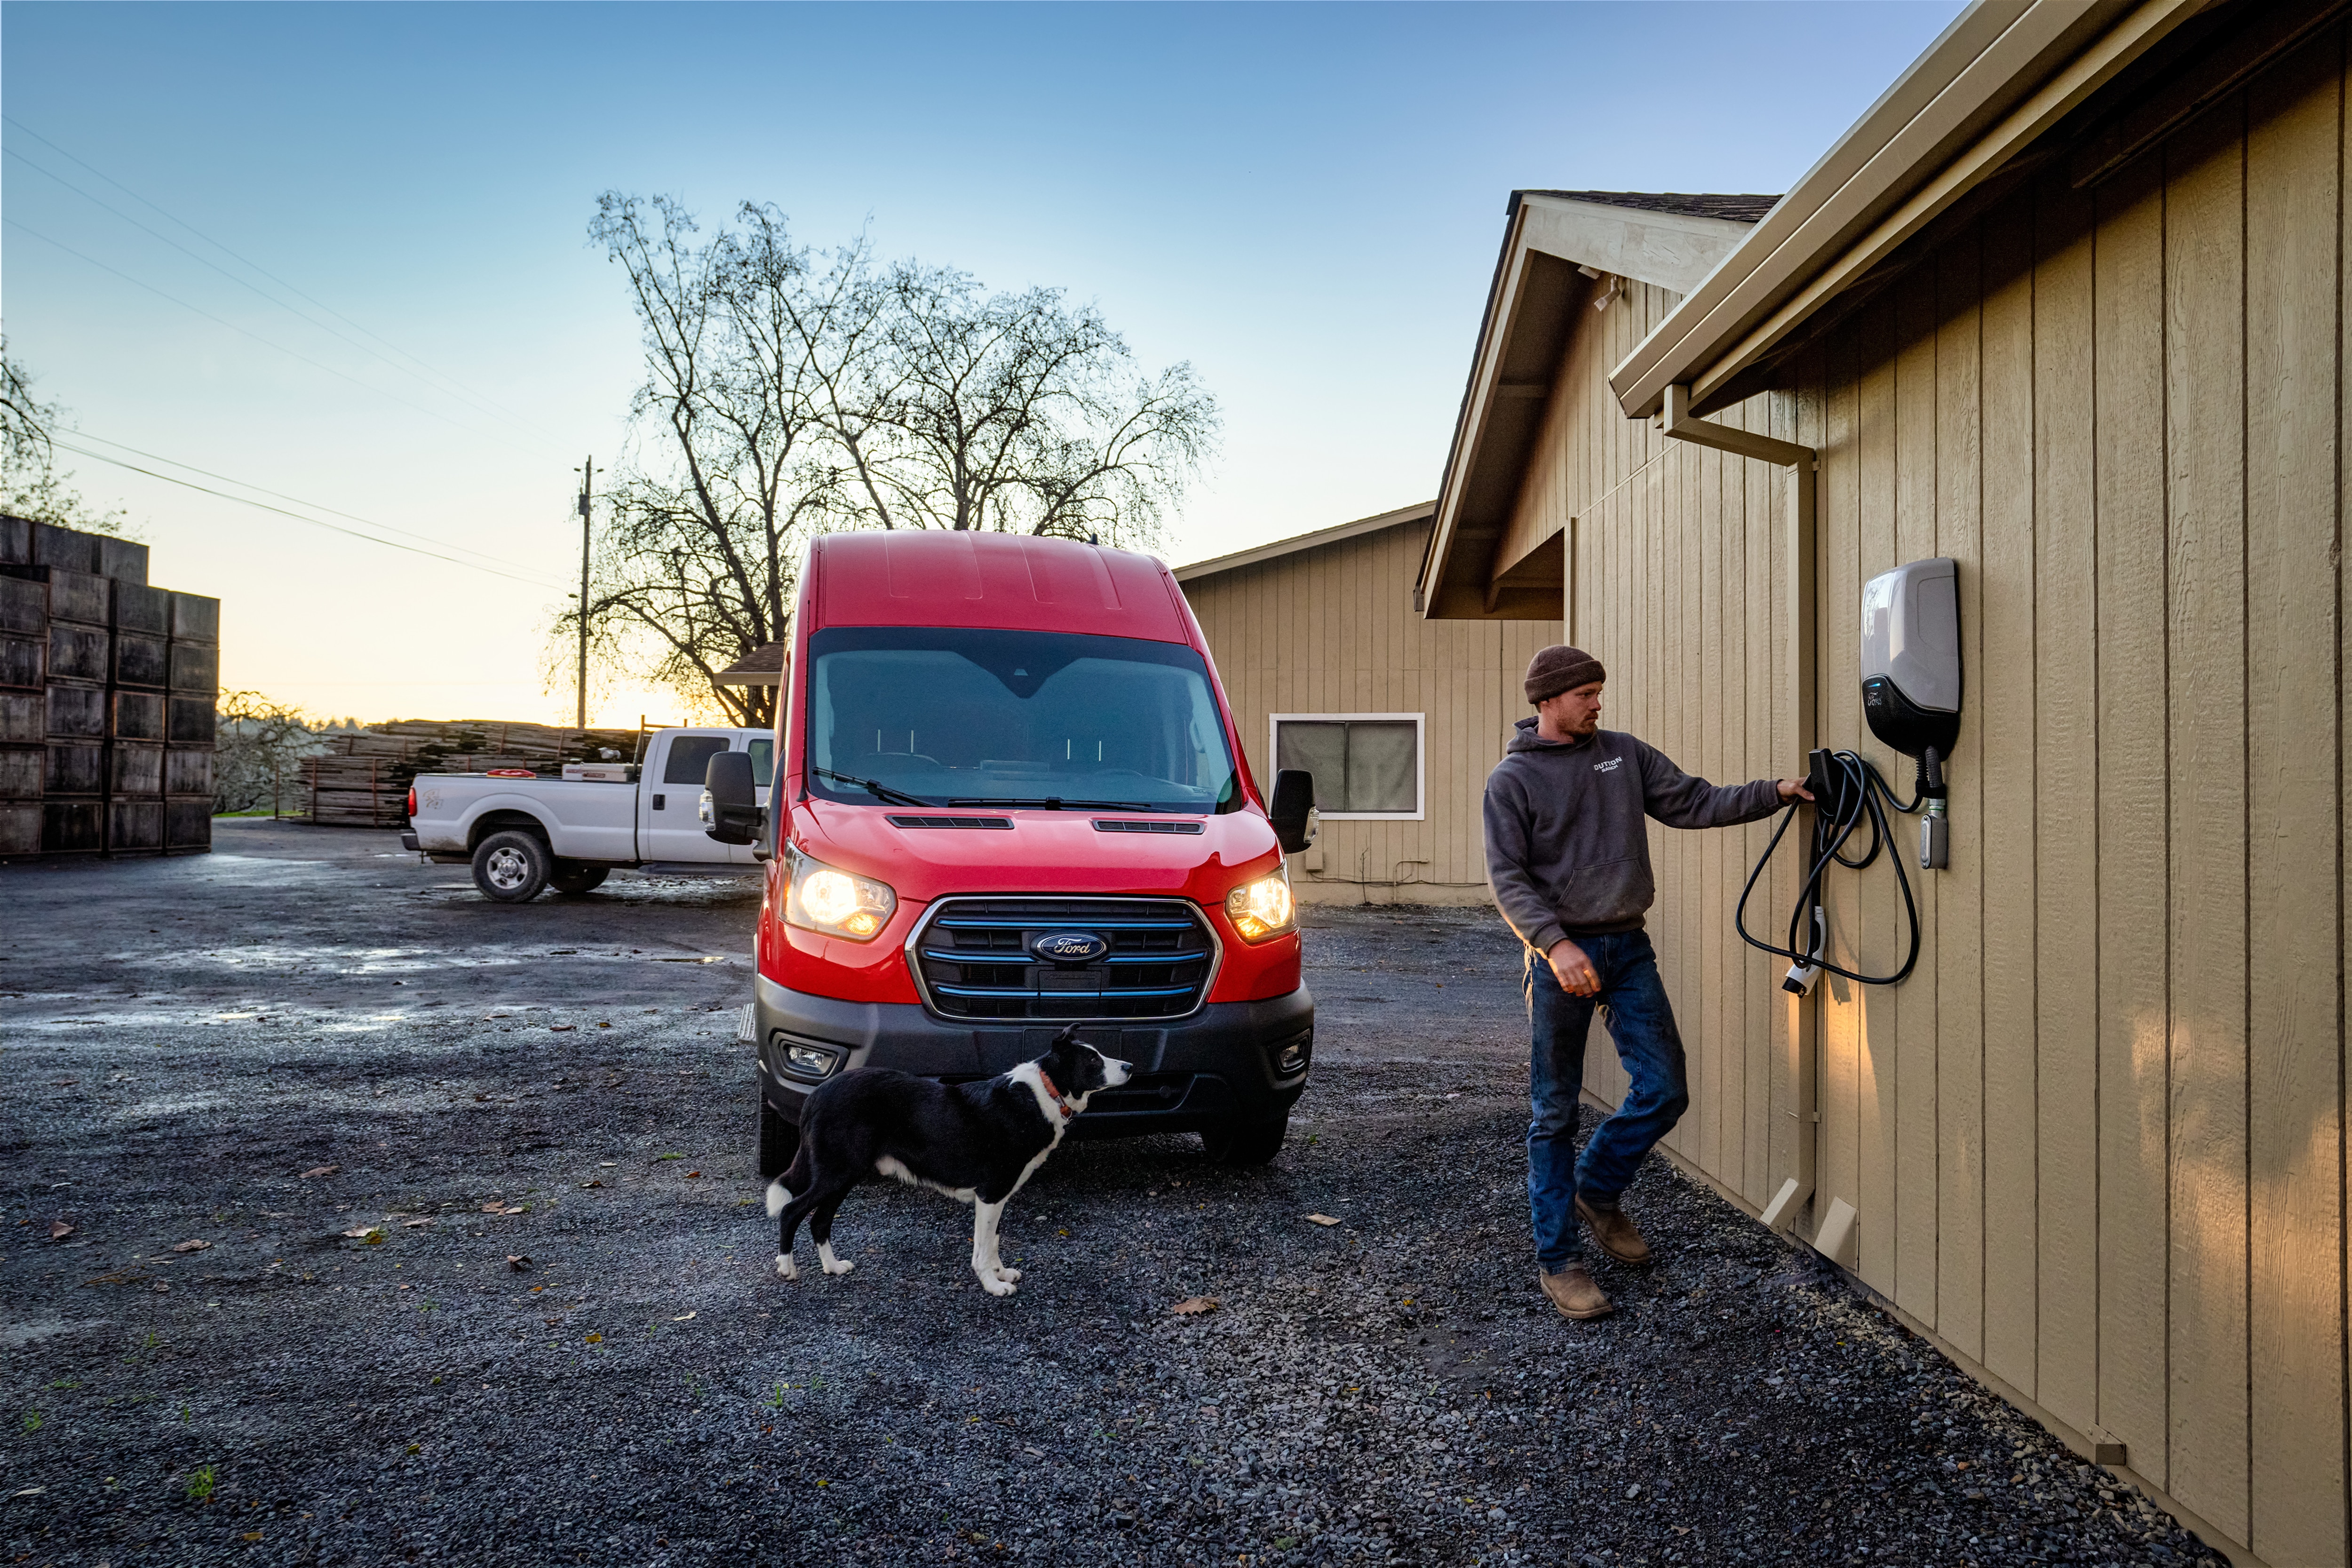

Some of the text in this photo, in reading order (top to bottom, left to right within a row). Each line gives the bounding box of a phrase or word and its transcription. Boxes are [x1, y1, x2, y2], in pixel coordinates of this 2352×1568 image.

[1868, 692, 1882, 706] Ford
[1594, 756, 1622, 771] DUTTON
[1054, 938, 1091, 954] Ford
